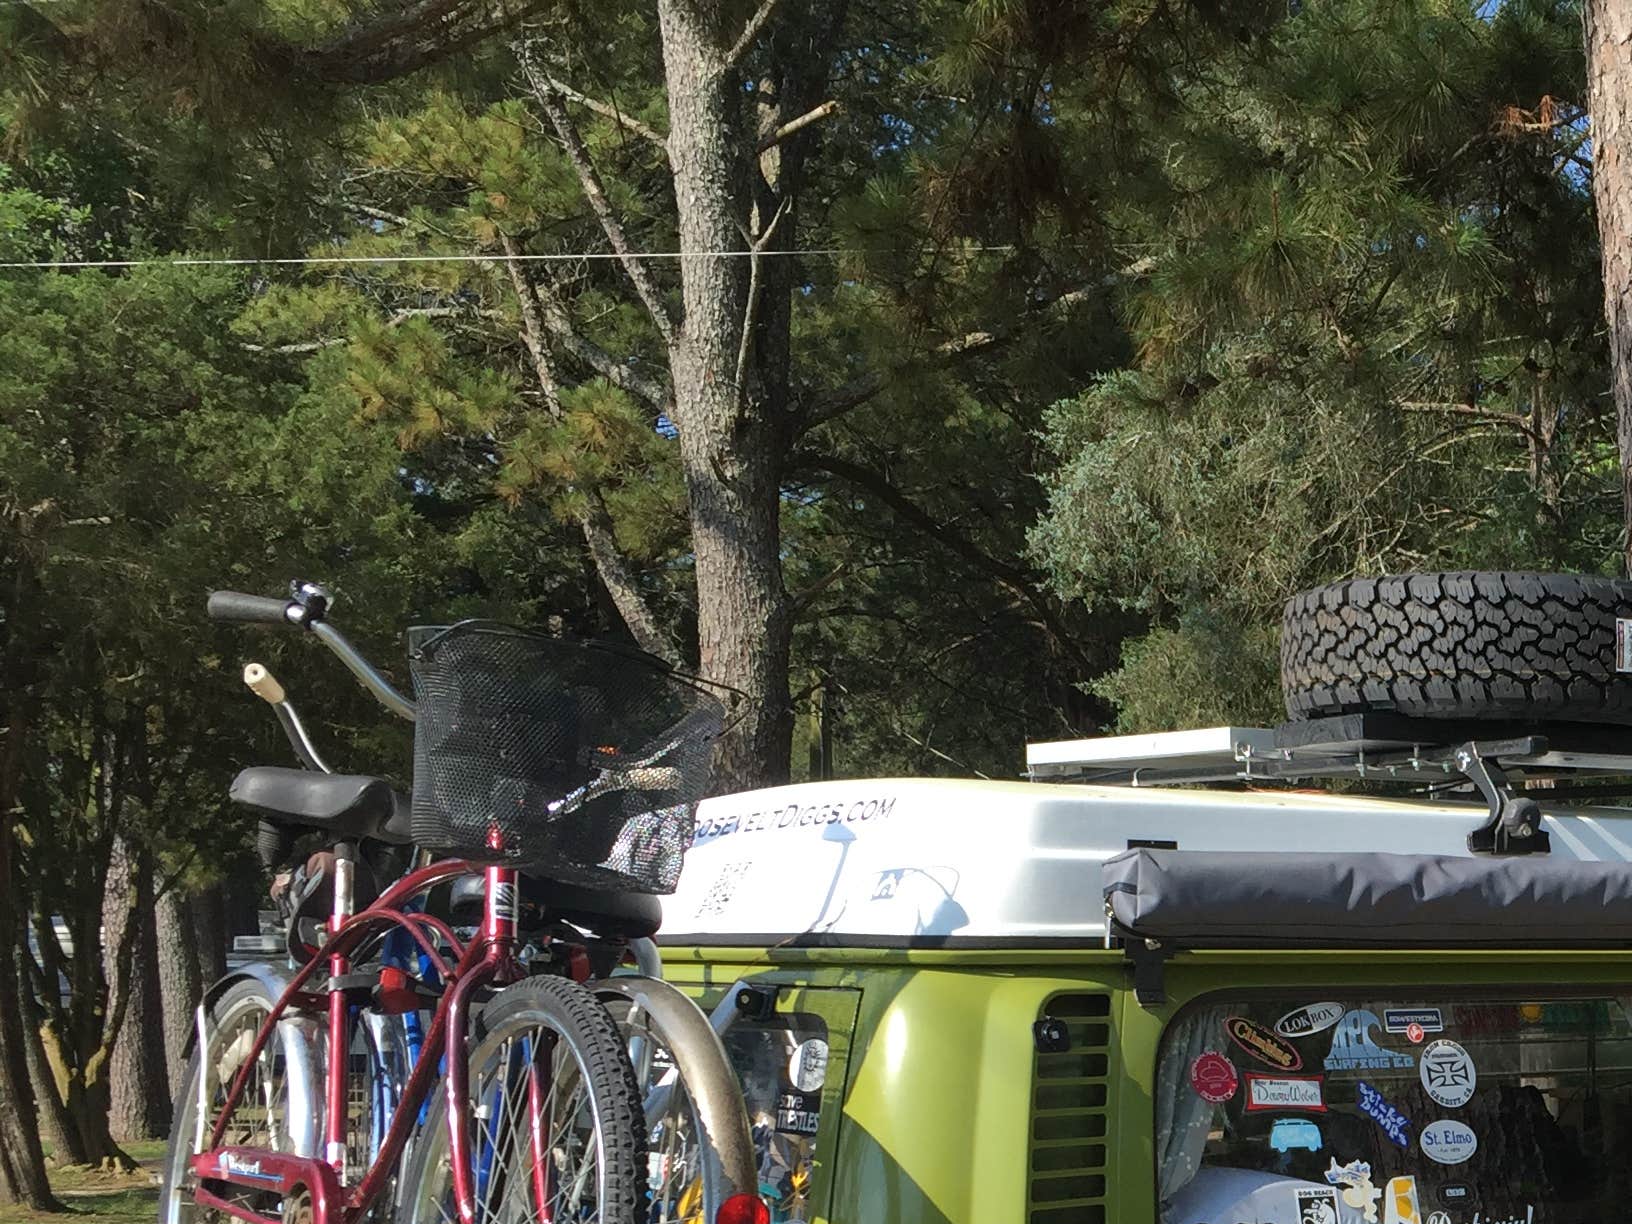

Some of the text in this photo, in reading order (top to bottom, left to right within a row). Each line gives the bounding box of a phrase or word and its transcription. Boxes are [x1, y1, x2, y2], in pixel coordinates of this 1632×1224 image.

[1323, 1056, 1390, 1072] SURFING
[1424, 1130, 1473, 1146] St. Elmo
